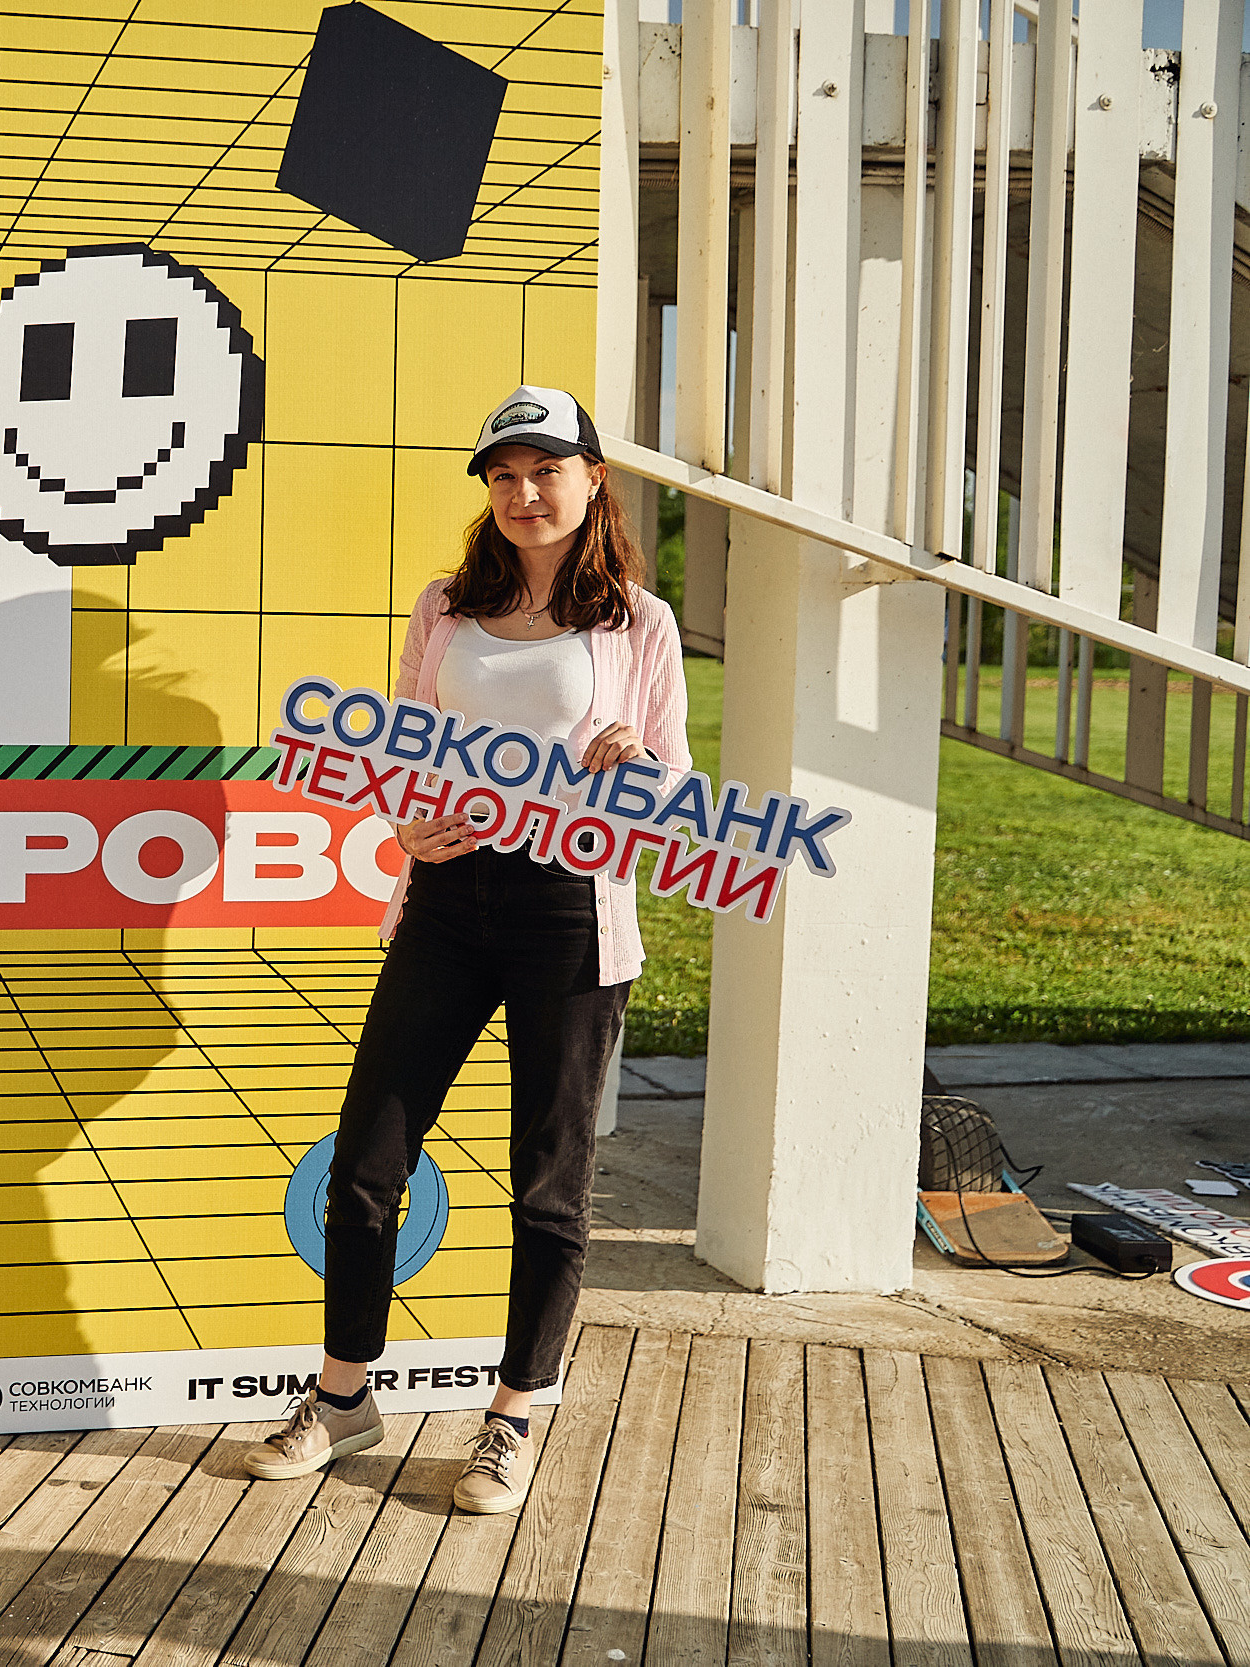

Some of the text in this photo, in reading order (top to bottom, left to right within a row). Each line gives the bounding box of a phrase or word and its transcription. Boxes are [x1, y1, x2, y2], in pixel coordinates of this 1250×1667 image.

[285, 681, 850, 871] СОВКОМБАНК
[273, 733, 780, 920] ТЕХНОЛОГИИ
[9, 1376, 153, 1397] СОВКОМБАНК
[187, 1378, 224, 1401] IT
[407, 1364, 501, 1390] FEST
[10, 1396, 115, 1412] ТЕХНОЛОГИИ
